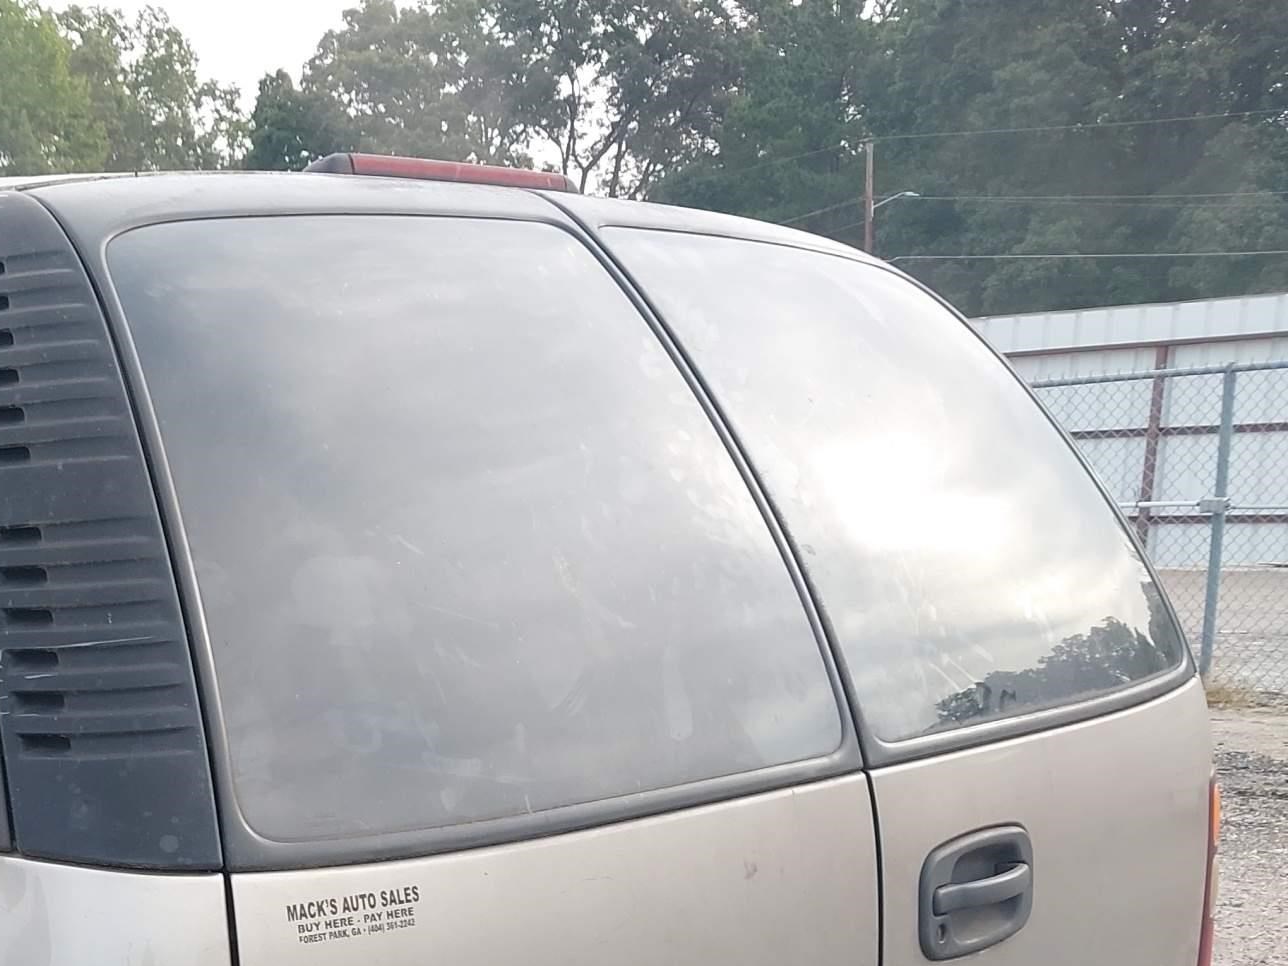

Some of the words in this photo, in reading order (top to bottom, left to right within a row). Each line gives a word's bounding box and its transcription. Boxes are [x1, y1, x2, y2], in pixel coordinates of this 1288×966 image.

[286, 898, 338, 922] MACK'S
[342, 892, 376, 914] AUTO
[380, 886, 420, 908] SALES
[297, 921, 321, 934] BUY
[324, 916, 354, 930] HERE
[363, 911, 384, 924] PAY
[386, 906, 415, 920] HERE
[298, 932, 327, 944] FOREST
[351, 928, 362, 937] GA
